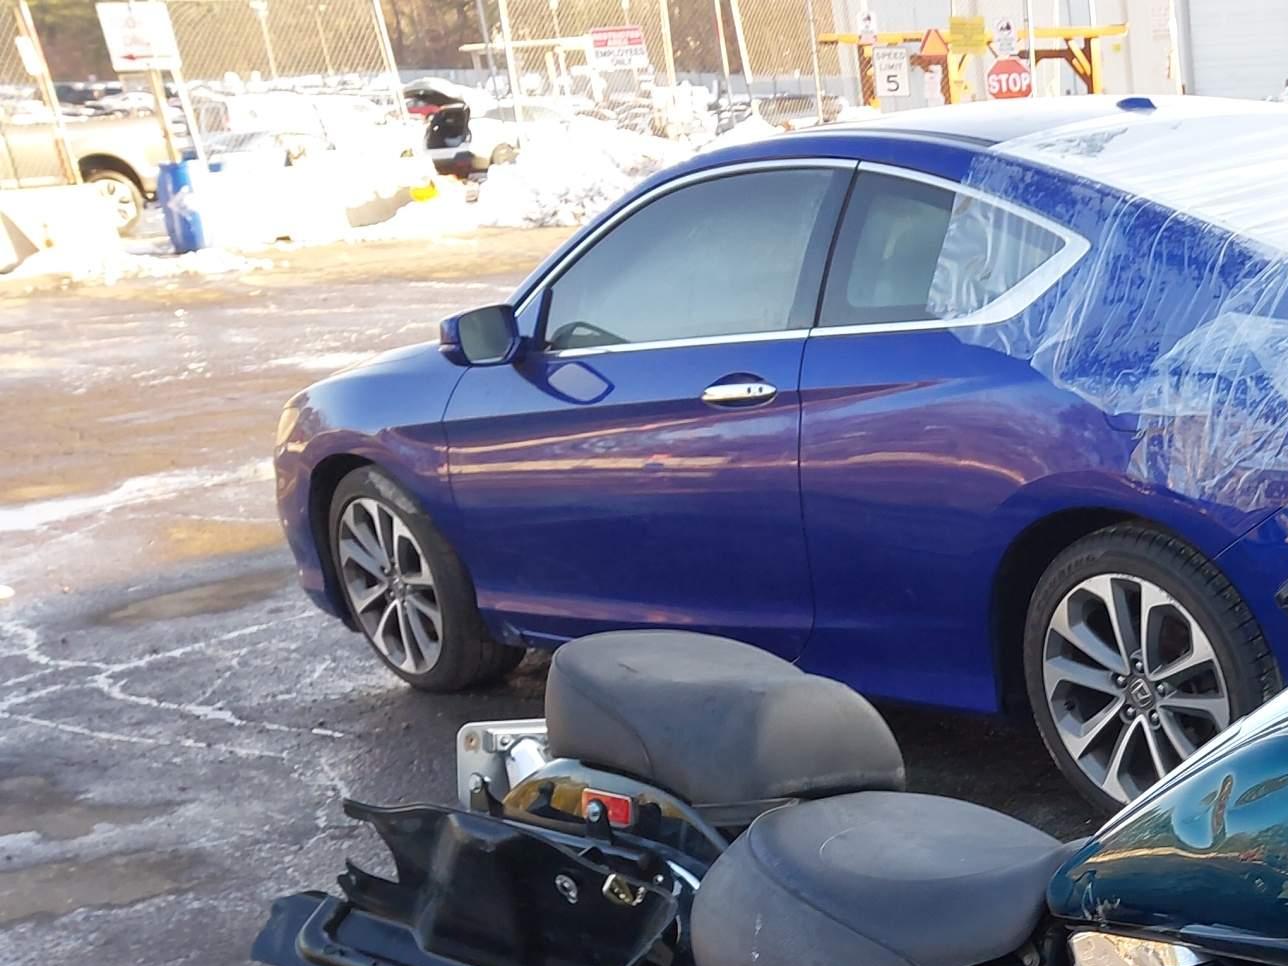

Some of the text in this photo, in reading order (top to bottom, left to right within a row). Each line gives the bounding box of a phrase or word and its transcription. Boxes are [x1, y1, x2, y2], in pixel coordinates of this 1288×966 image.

[876, 51, 905, 60] SPEED
[879, 62, 903, 71] LIMIT
[886, 74, 900, 92] 5
[988, 72, 1030, 95] STOP
